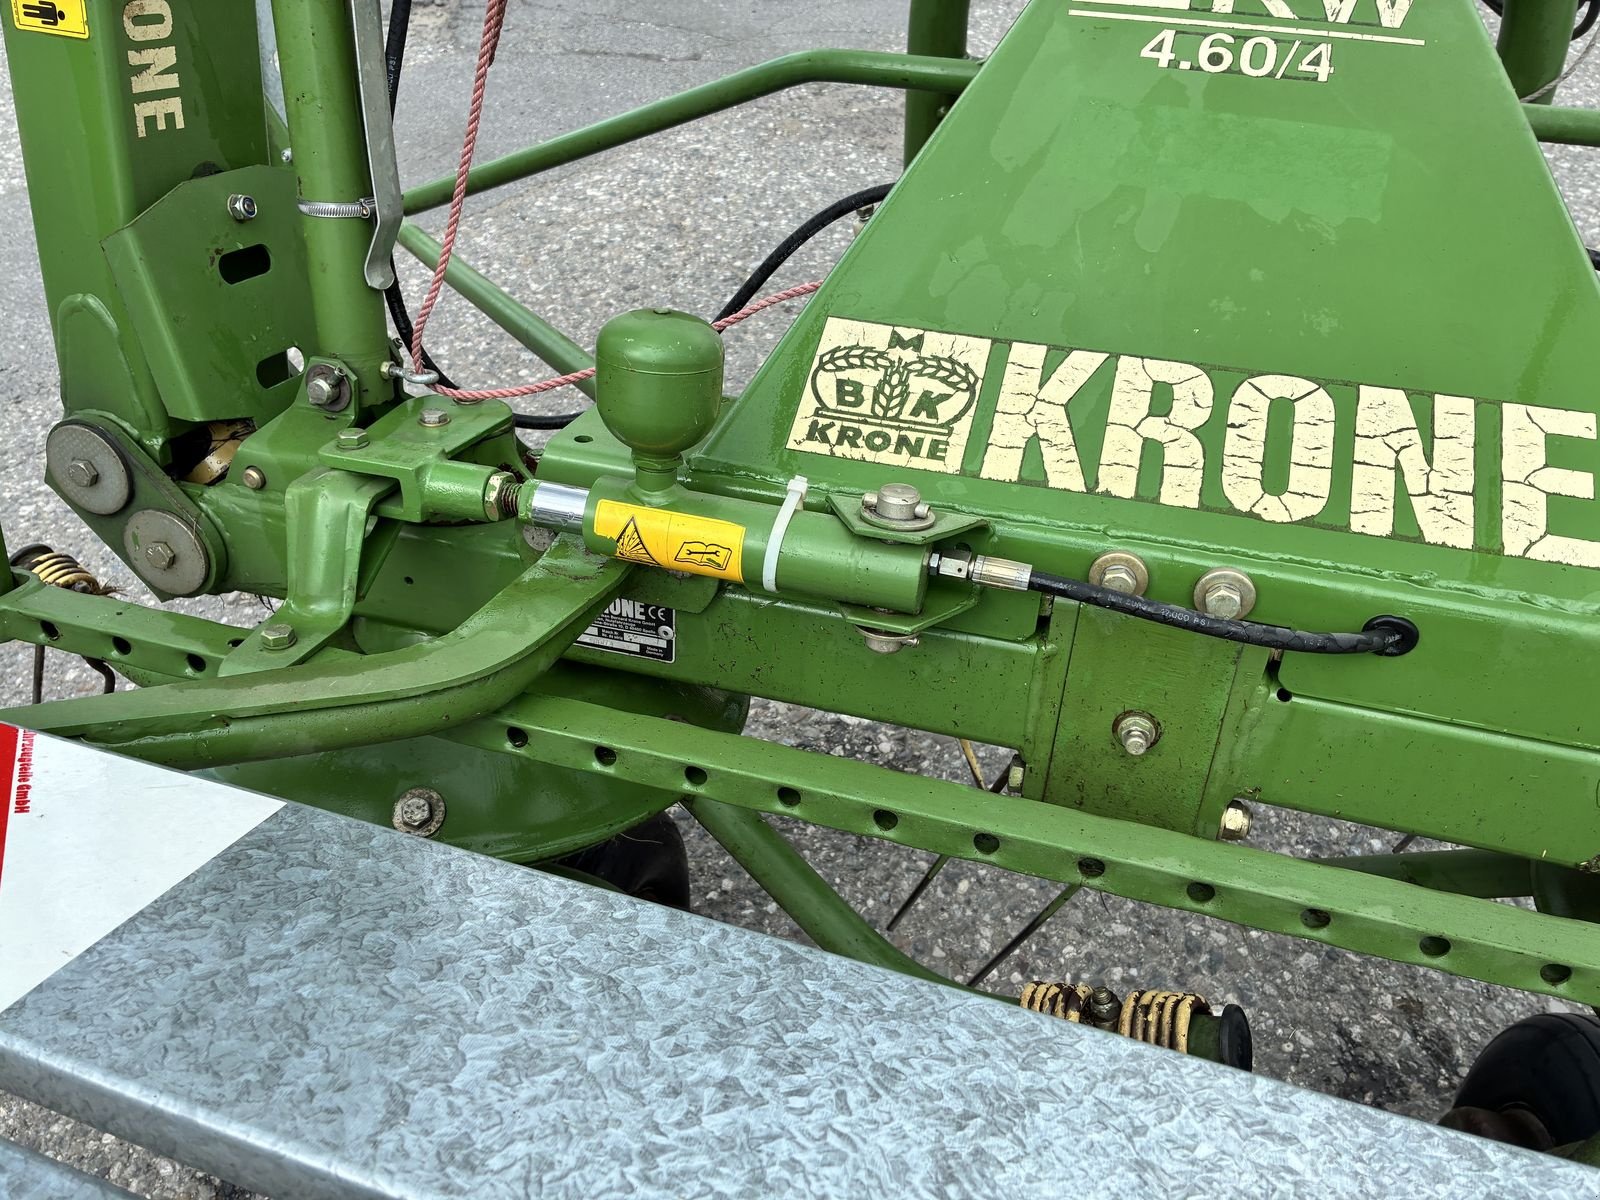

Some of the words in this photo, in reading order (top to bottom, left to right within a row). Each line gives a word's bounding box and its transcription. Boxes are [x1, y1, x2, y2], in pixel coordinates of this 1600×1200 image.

[1140, 29, 1335, 83] 4.60/4
[805, 420, 950, 461] KRONE
[979, 341, 1600, 568] KRONE
[14, 783, 33, 814] GmbH
